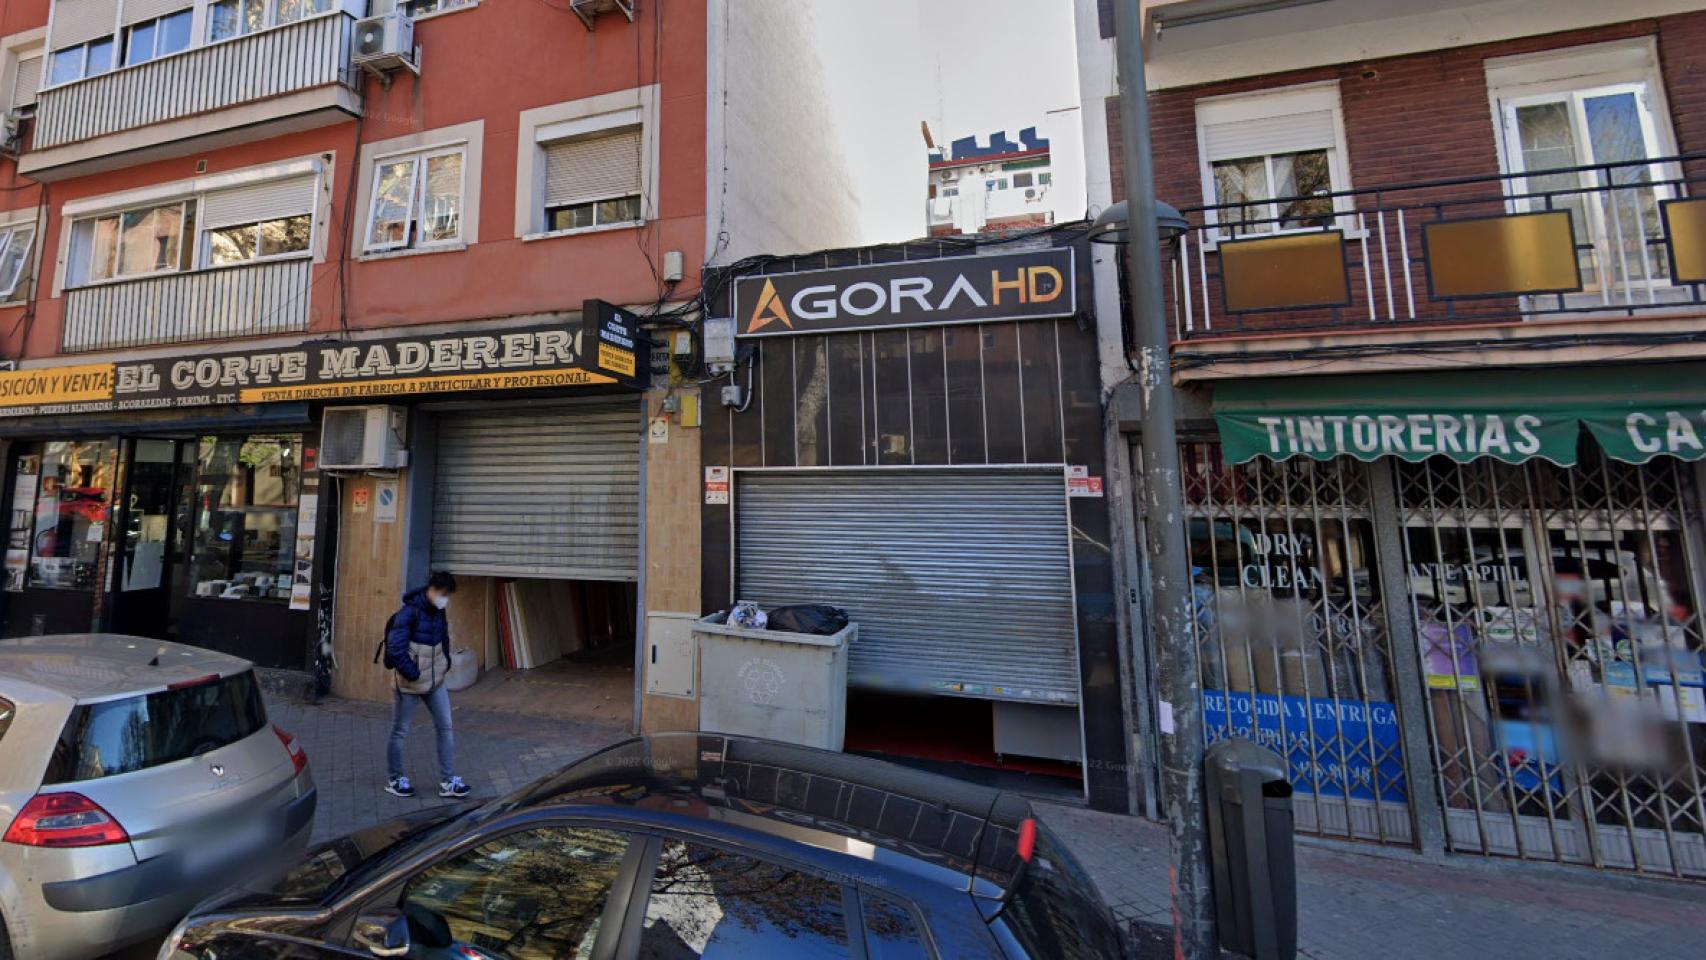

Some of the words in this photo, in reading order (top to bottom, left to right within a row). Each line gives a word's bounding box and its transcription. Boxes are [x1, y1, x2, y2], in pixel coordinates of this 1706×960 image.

[116, 363, 161, 394] EL
[170, 351, 307, 391] CORTE
[318, 329, 583, 380] MADERER
[0, 373, 48, 397] SICIÓN
[51, 376, 60, 394] Y
[62, 371, 108, 393] VENTA
[262, 389, 293, 401] VENTA
[296, 386, 340, 399] DIRECTA
[342, 385, 357, 396] DE
[408, 381, 416, 393] A
[418, 376, 492, 393] PARTICULAR
[492, 376, 501, 388] Y
[503, 371, 591, 388] PROFESIONAL
[1257, 413, 1542, 456] TINTORERIAS
[1625, 410, 1706, 453] CA
[1204, 694, 1292, 718] RECOGIDA
[1296, 701, 1308, 719] Y
